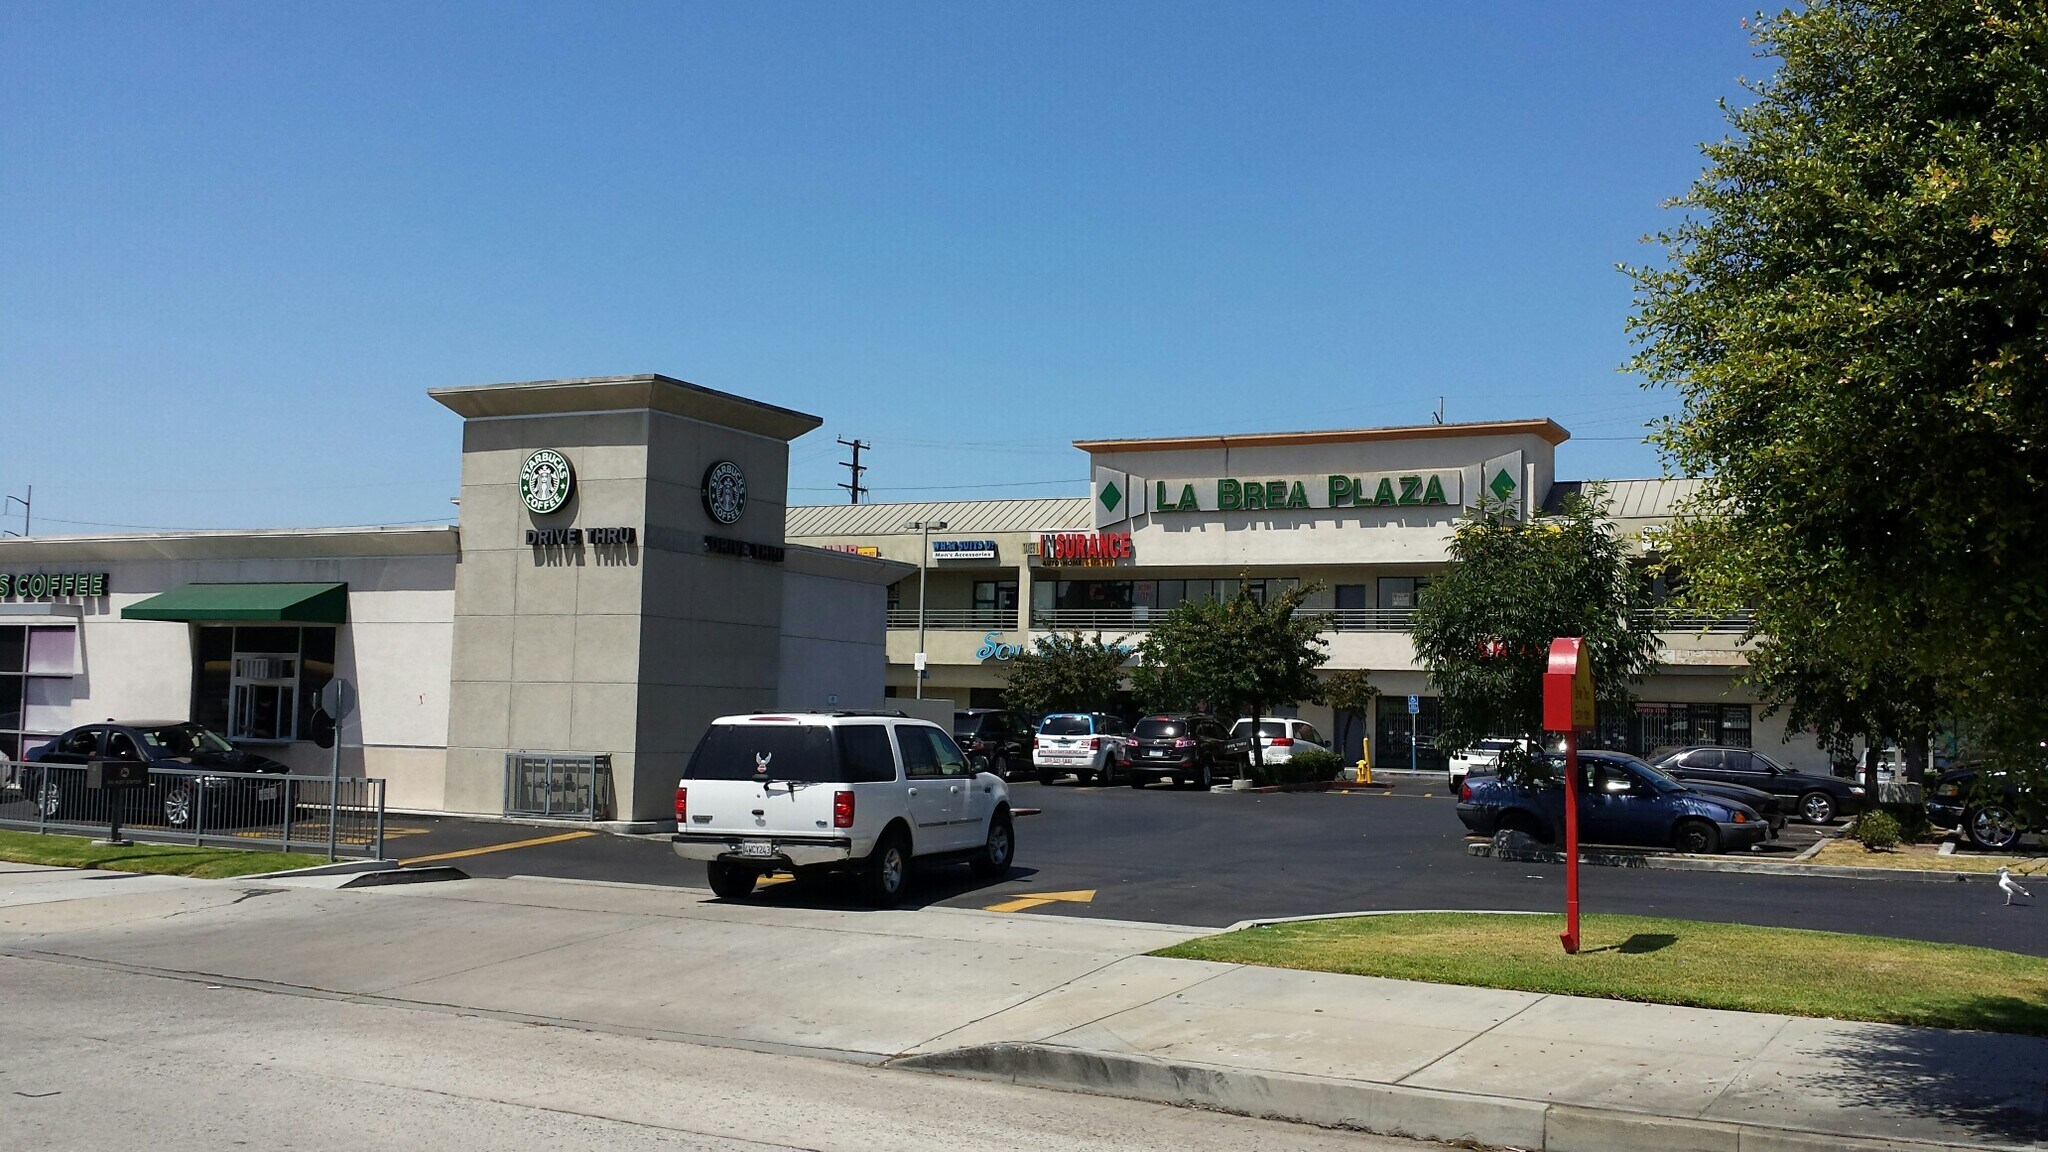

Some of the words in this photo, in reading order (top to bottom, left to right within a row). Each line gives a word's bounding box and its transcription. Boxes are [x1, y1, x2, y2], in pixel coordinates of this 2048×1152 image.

[522, 452, 567, 481] STARBUCKS
[711, 465, 745, 494] STARBUCKS
[525, 493, 562, 511] COFFEE
[1156, 481, 1200, 511] LA
[1217, 478, 1311, 510] BREA
[1328, 474, 1448, 507] PLAZA
[713, 502, 740, 521] COFFEE
[525, 528, 578, 546] DRIVE
[585, 526, 632, 544] THRU
[708, 537, 751, 557] DRIVE
[933, 542, 958, 551] WHAT
[959, 541, 983, 551] SUITS
[1040, 533, 1132, 559] INSURANCE
[15, 573, 104, 597] COFFEE
